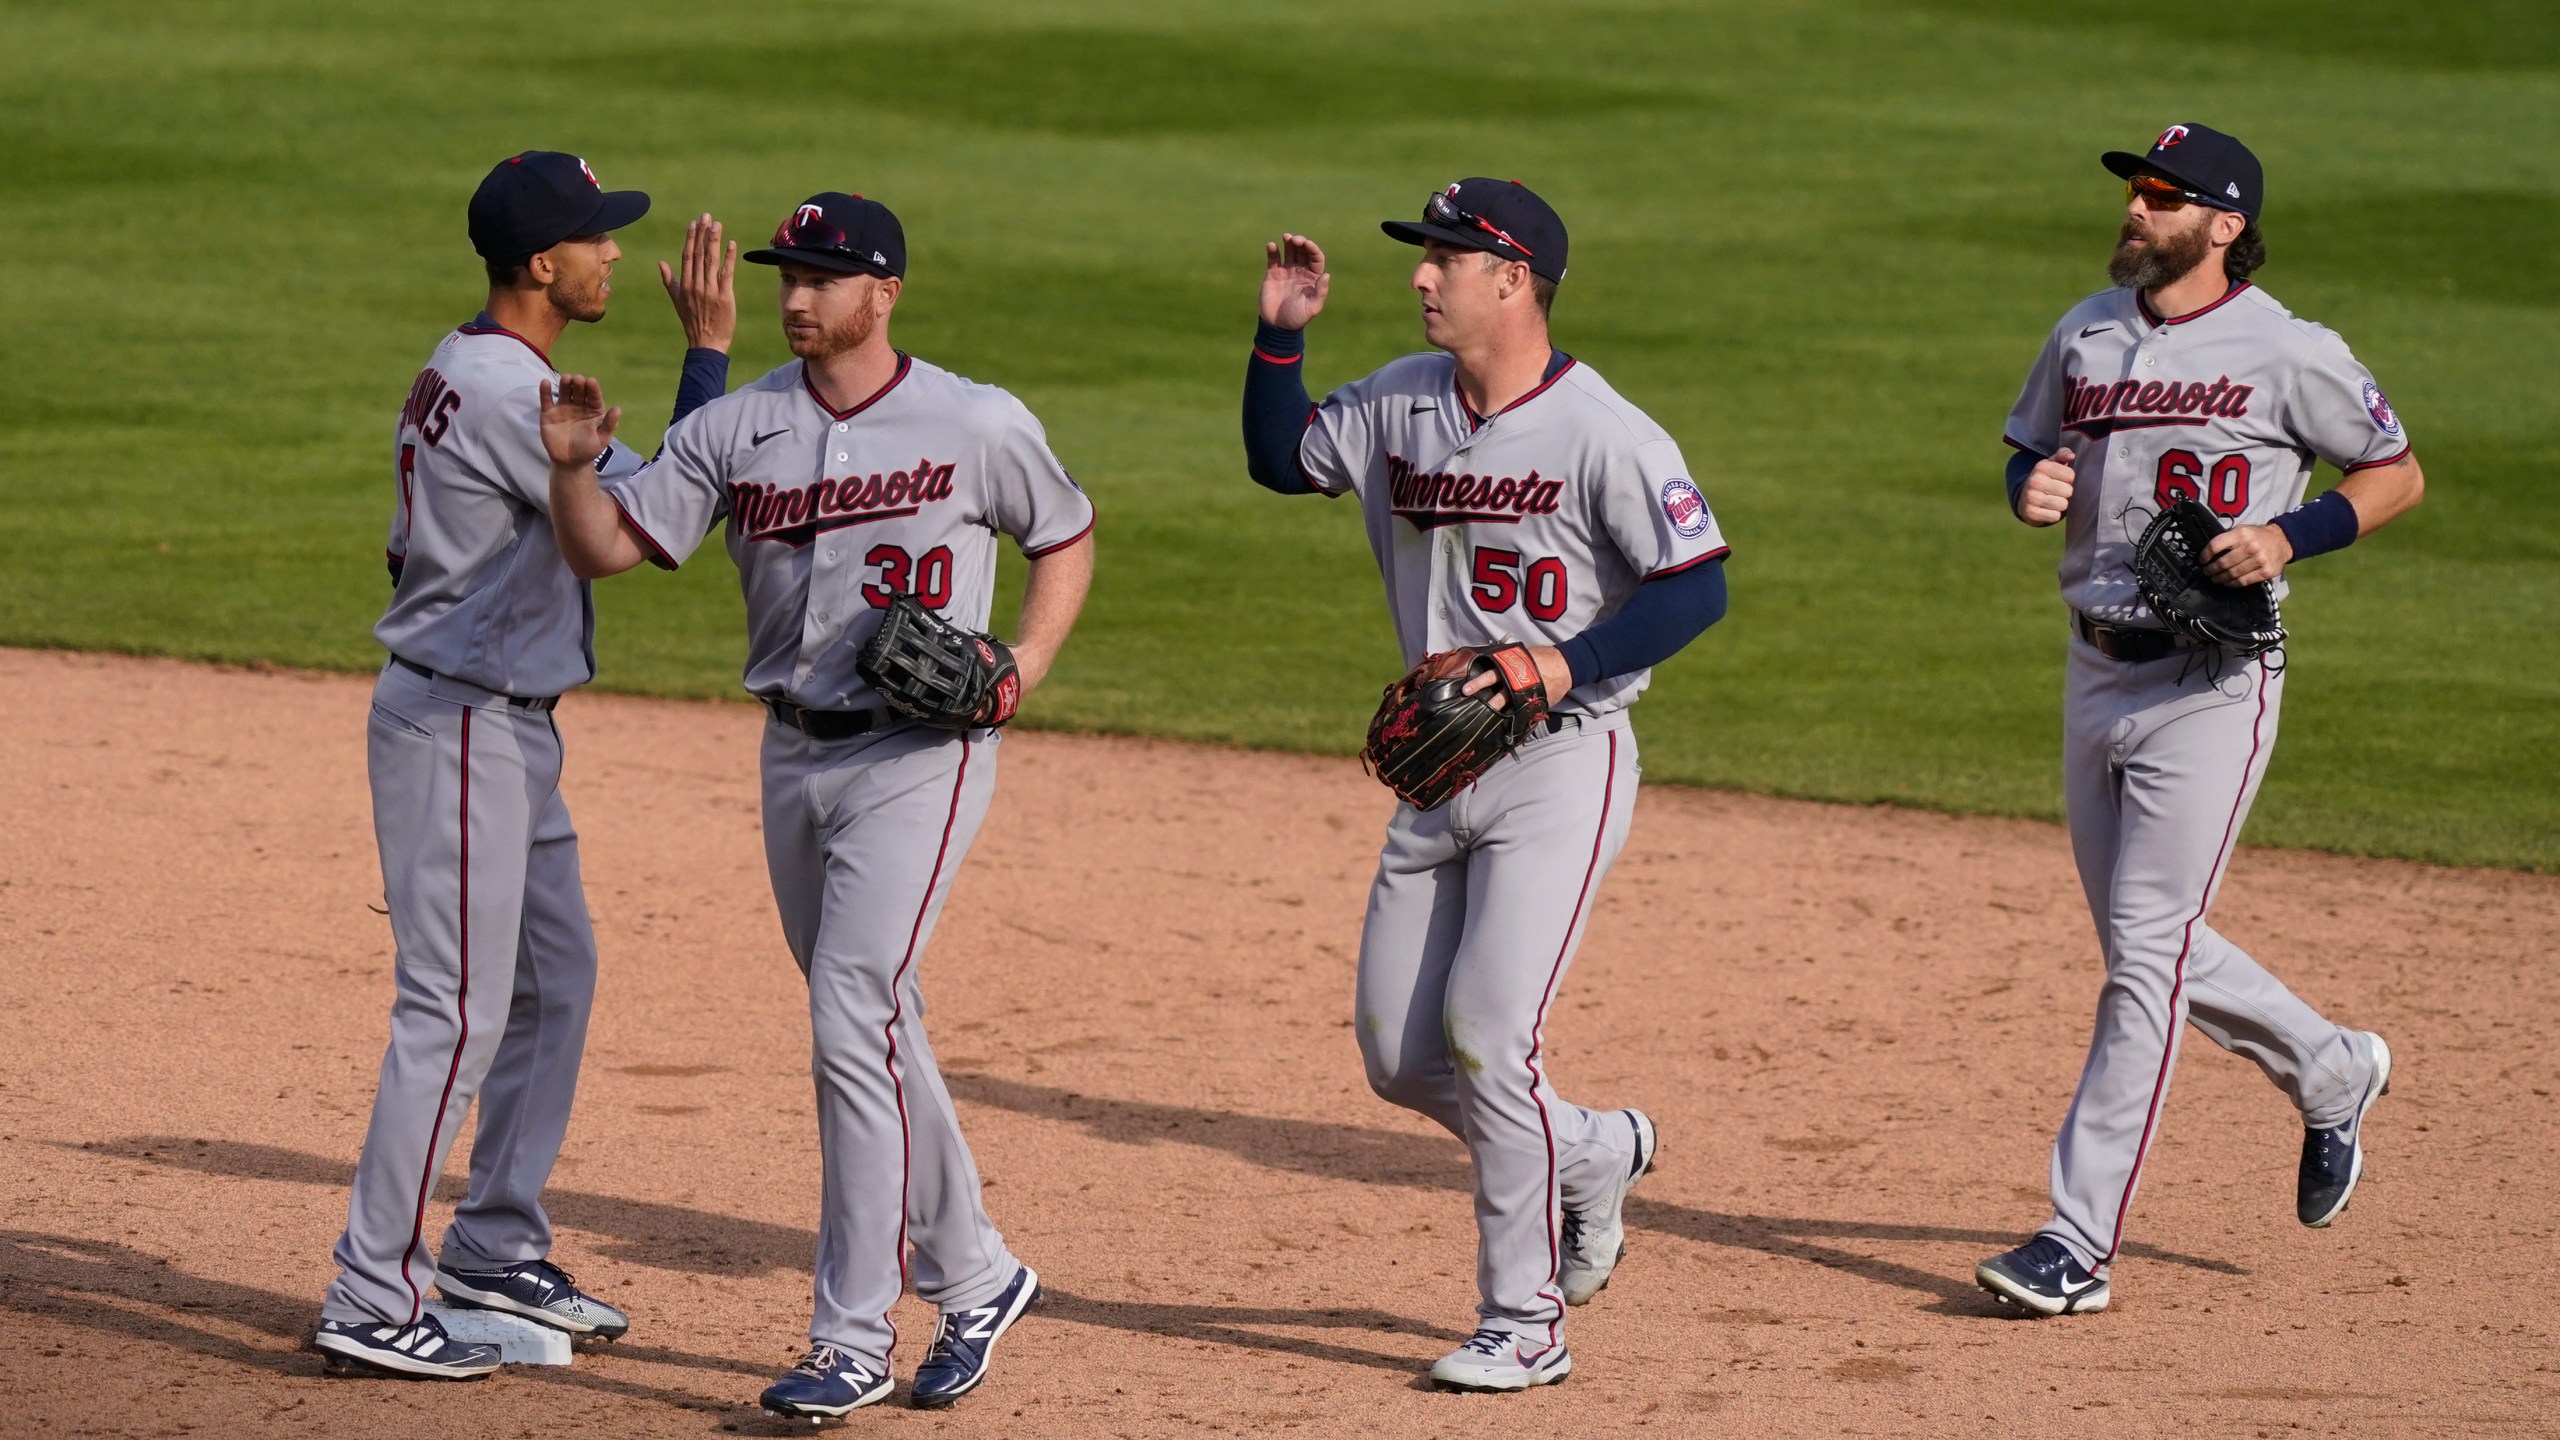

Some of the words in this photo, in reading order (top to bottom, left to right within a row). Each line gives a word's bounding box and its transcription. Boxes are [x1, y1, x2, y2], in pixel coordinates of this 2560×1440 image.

[727, 458, 957, 537] Minnesota
[1385, 451, 1564, 516] Minnesota
[2153, 448, 2252, 518] 60
[861, 544, 954, 610] 30
[1471, 545, 1568, 623] 50
